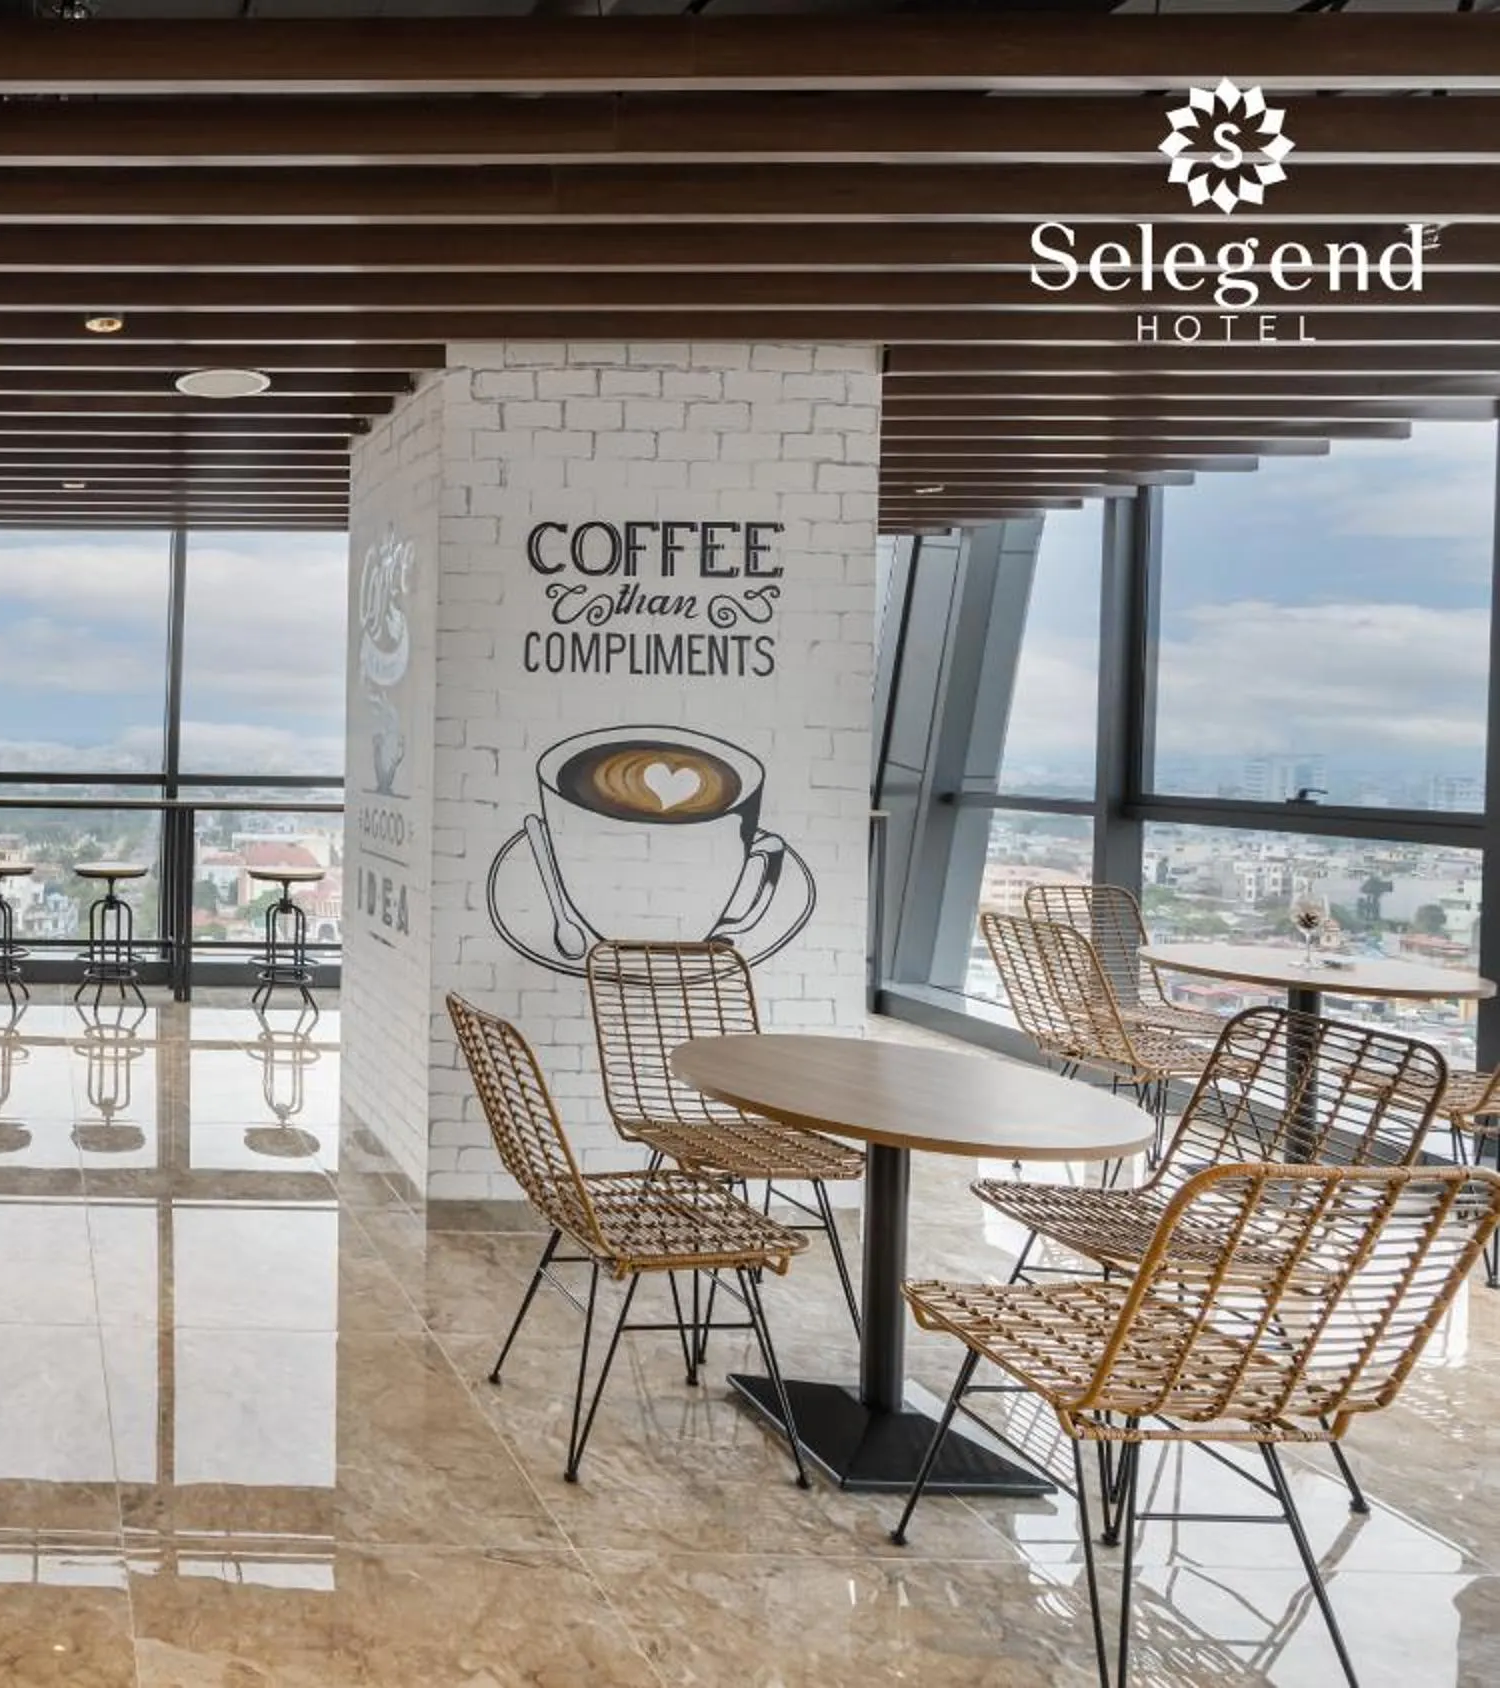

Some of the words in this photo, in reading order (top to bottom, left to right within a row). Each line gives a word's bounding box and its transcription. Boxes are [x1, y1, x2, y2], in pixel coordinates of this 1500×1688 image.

[527, 521, 785, 578] COFFEE
[614, 583, 699, 619] than
[523, 631, 776, 677] COMPLIMENTS
[357, 866, 409, 936] IDEA
